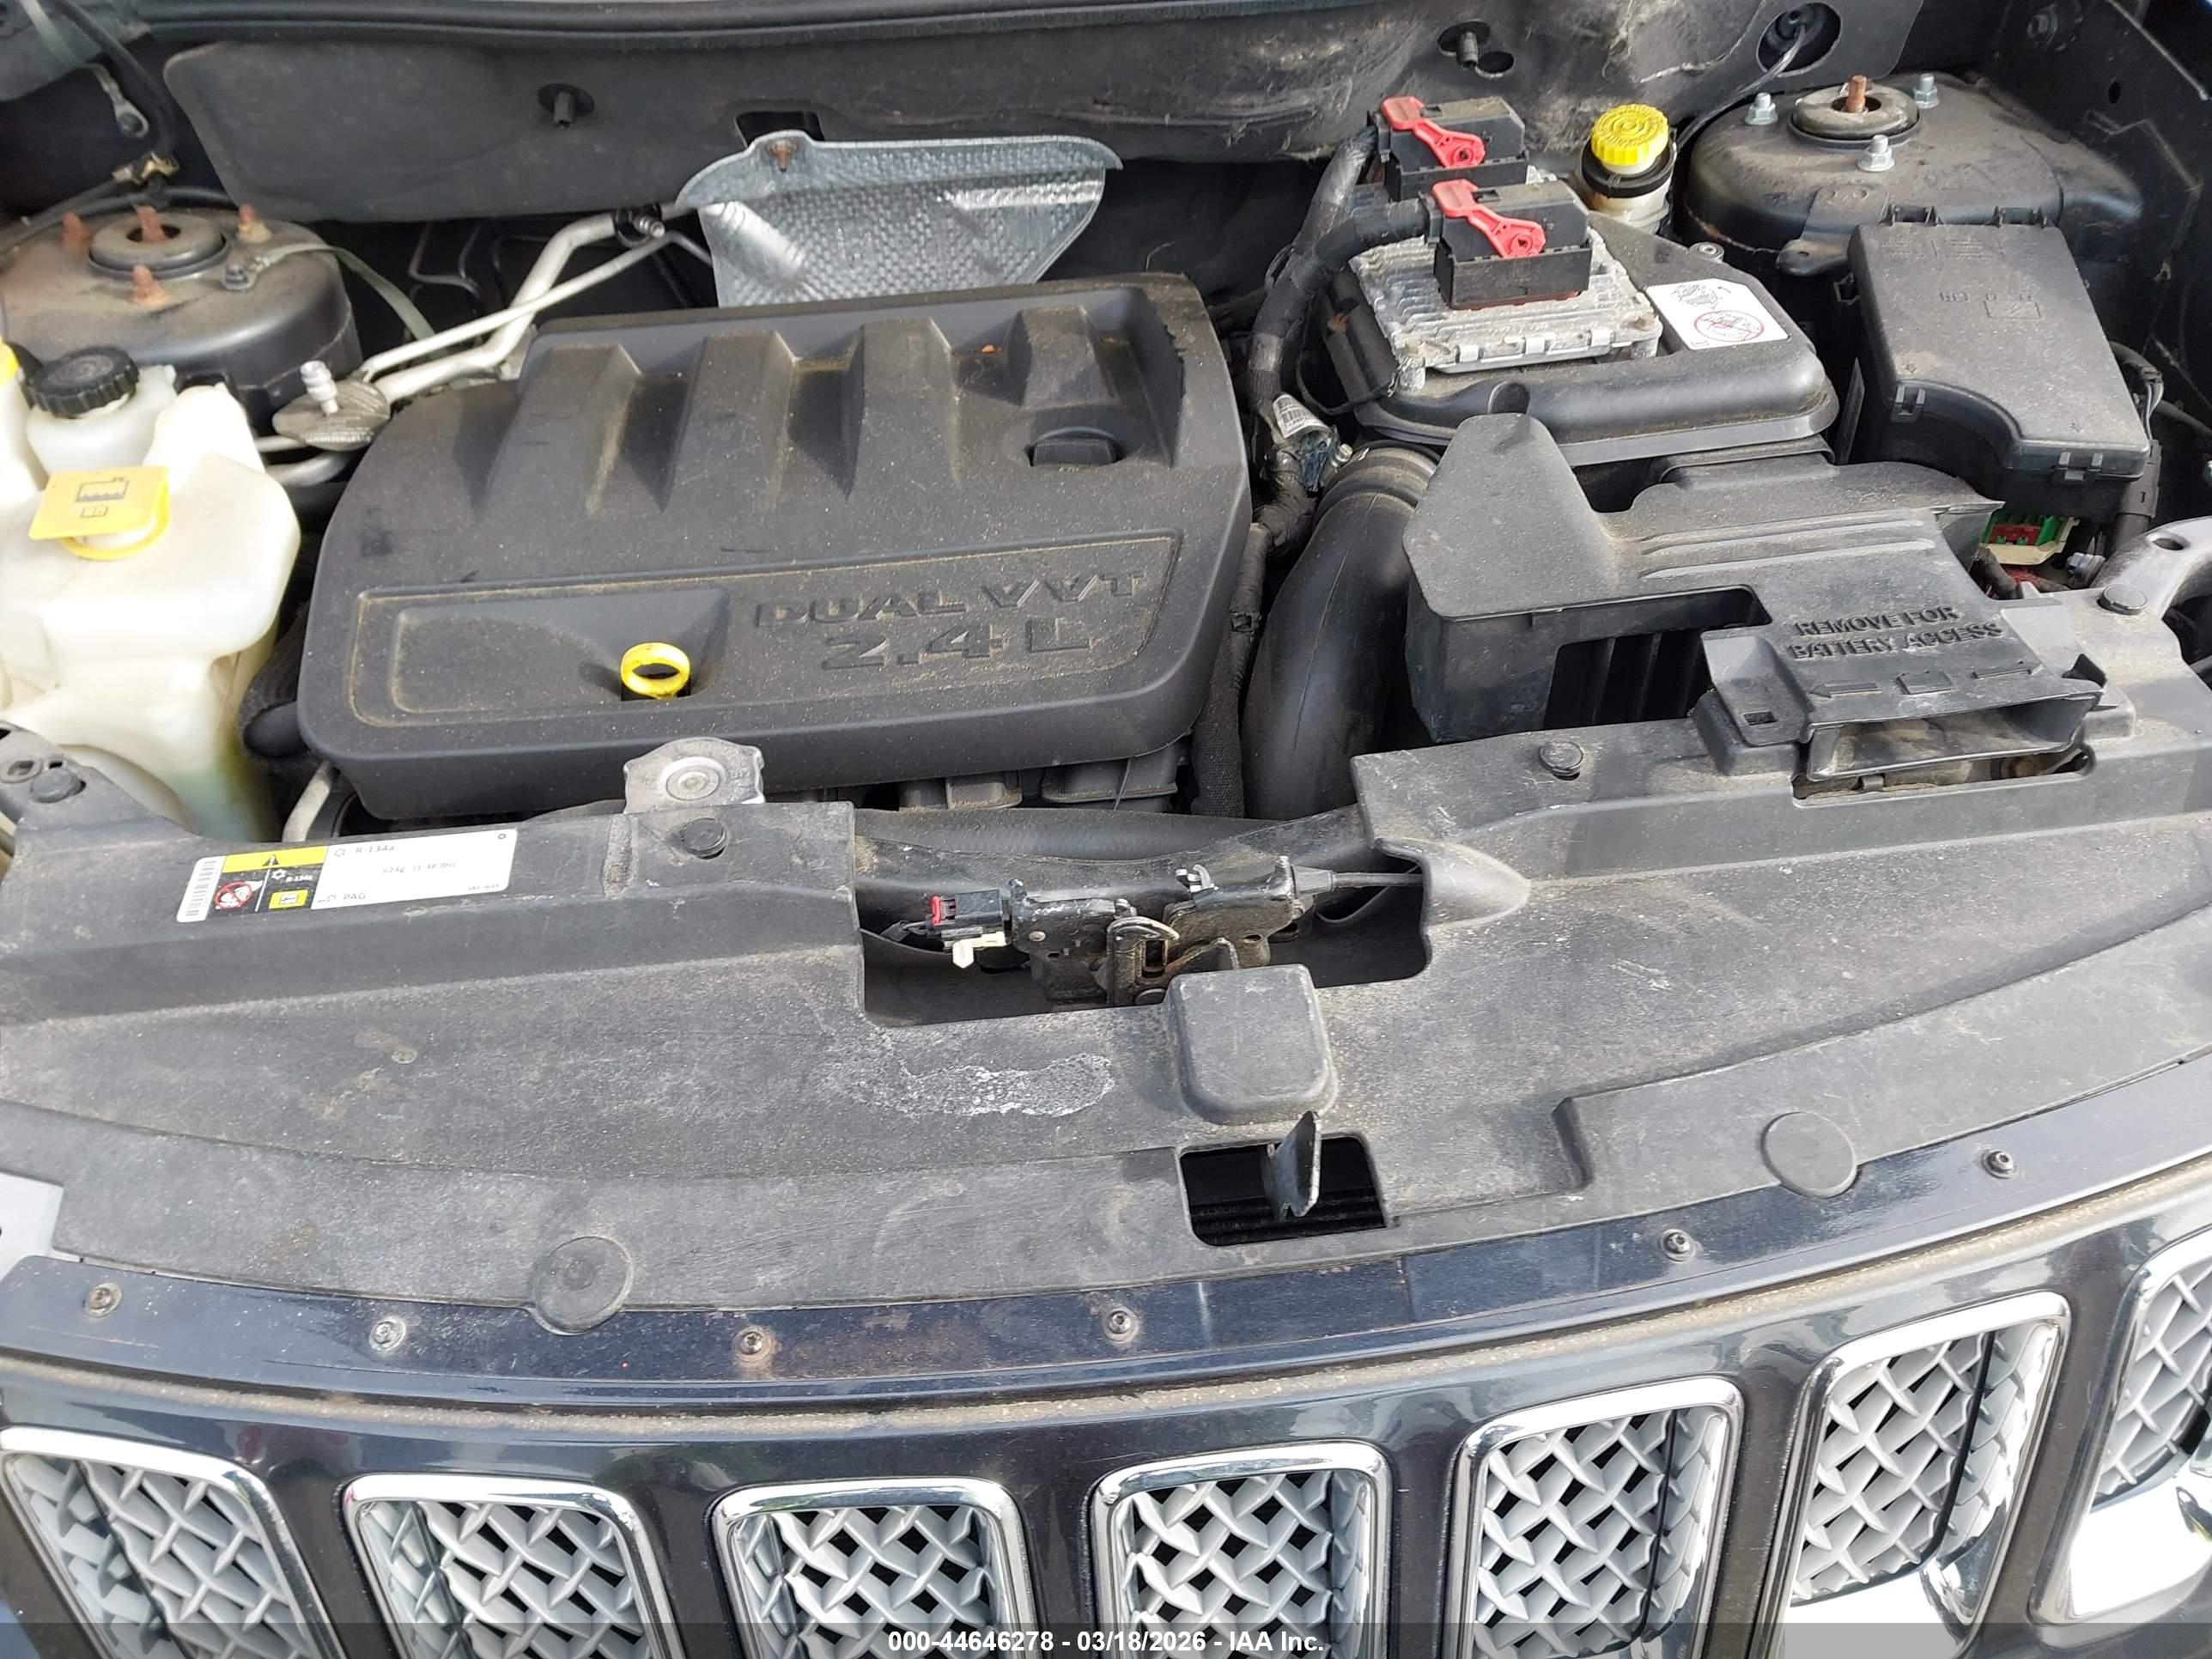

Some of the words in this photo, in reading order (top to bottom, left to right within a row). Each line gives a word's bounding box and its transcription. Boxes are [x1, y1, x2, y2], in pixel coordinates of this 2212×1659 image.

[755, 591, 969, 627] DUAL
[981, 572, 1149, 609] VVT
[1794, 612, 1903, 637] REMOVE
[1904, 605, 1962, 627] FOR
[1786, 635, 1895, 659] BATTERY
[1903, 621, 2004, 648] ACCESS
[343, 891, 368, 902] PAG
